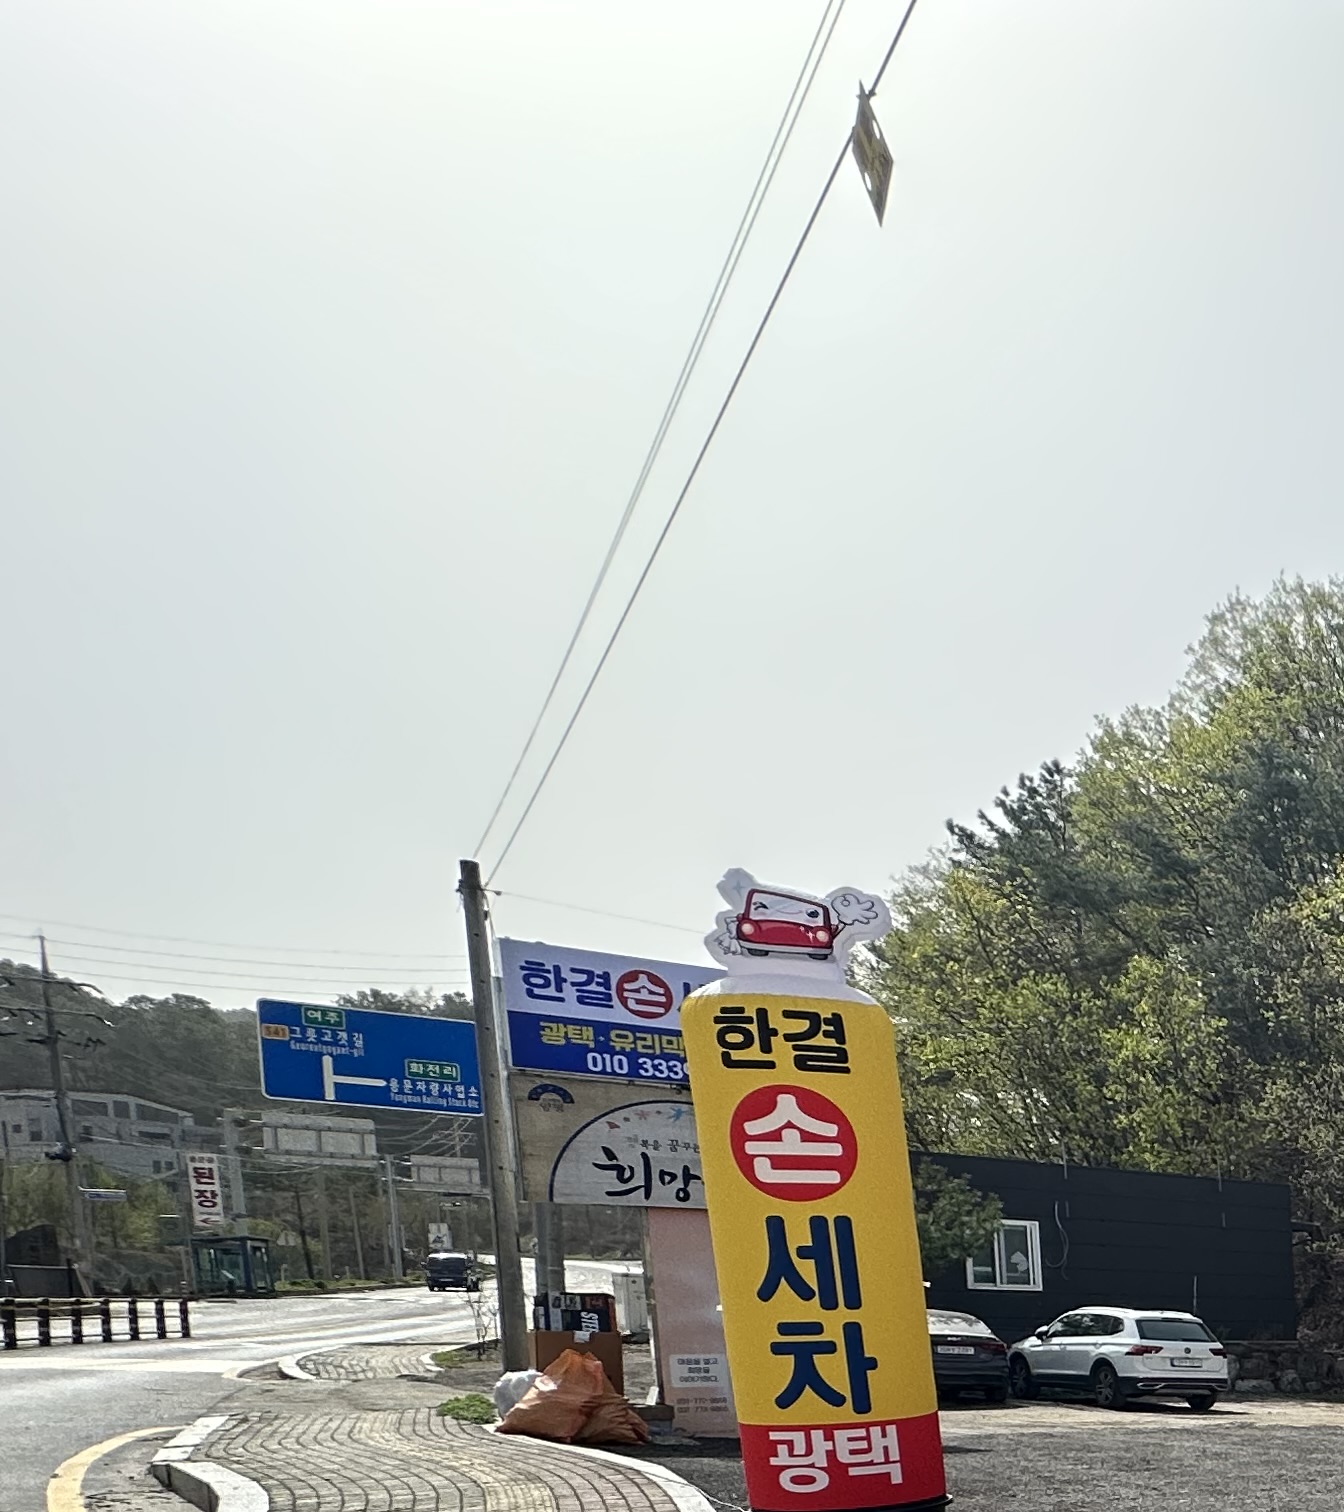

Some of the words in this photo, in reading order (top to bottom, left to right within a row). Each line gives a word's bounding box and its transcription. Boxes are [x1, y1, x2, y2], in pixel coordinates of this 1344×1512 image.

[306, 1010, 340, 1023] 여주
[539, 1021, 596, 1048] 광택
[713, 1006, 851, 1074] 한결
[409, 1062, 456, 1078] 화전리
[587, 1052, 629, 1075] 010
[193, 1166, 219, 1209] 된장
[768, 1424, 905, 1494] 광택
